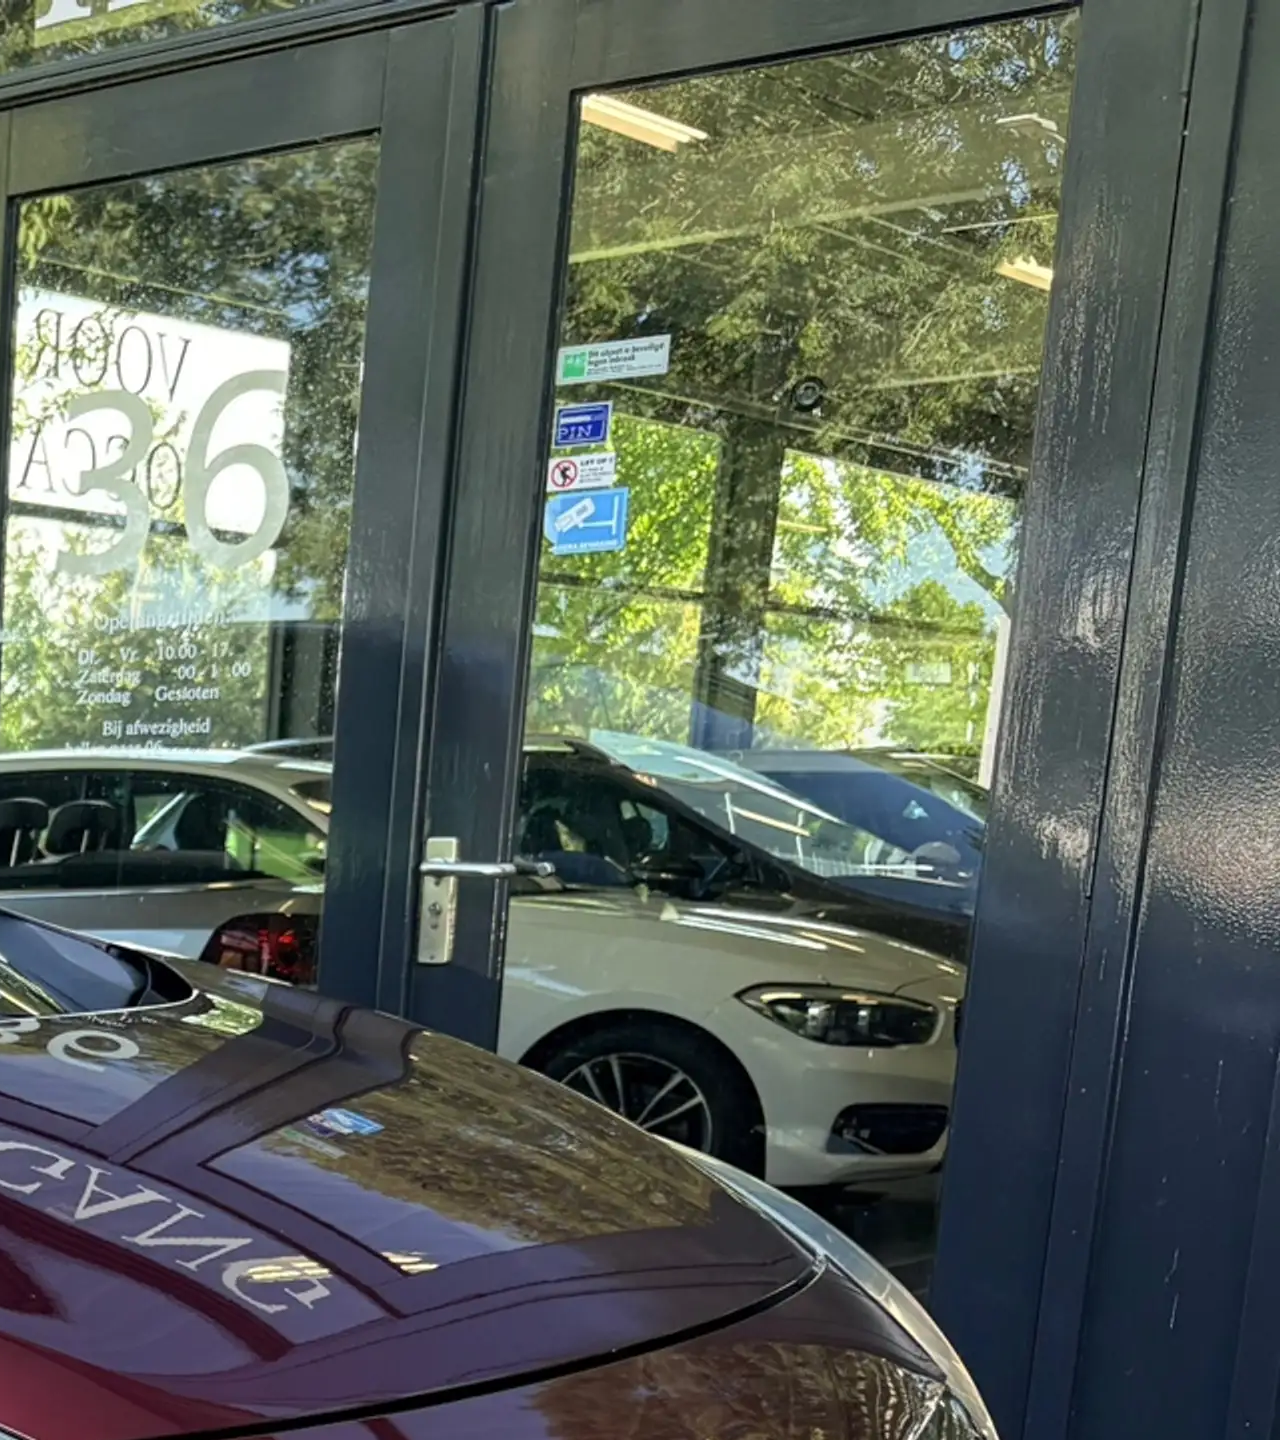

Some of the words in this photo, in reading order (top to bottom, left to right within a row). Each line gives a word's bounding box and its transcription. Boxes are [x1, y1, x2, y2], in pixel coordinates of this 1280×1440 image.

[558, 424, 593, 440] PIN
[54, 368, 292, 576] 36
[75, 689, 133, 708] Zondag
[154, 685, 220, 702] Gesloten
[102, 720, 123, 739] Bij
[125, 717, 212, 738] afwezigheid
